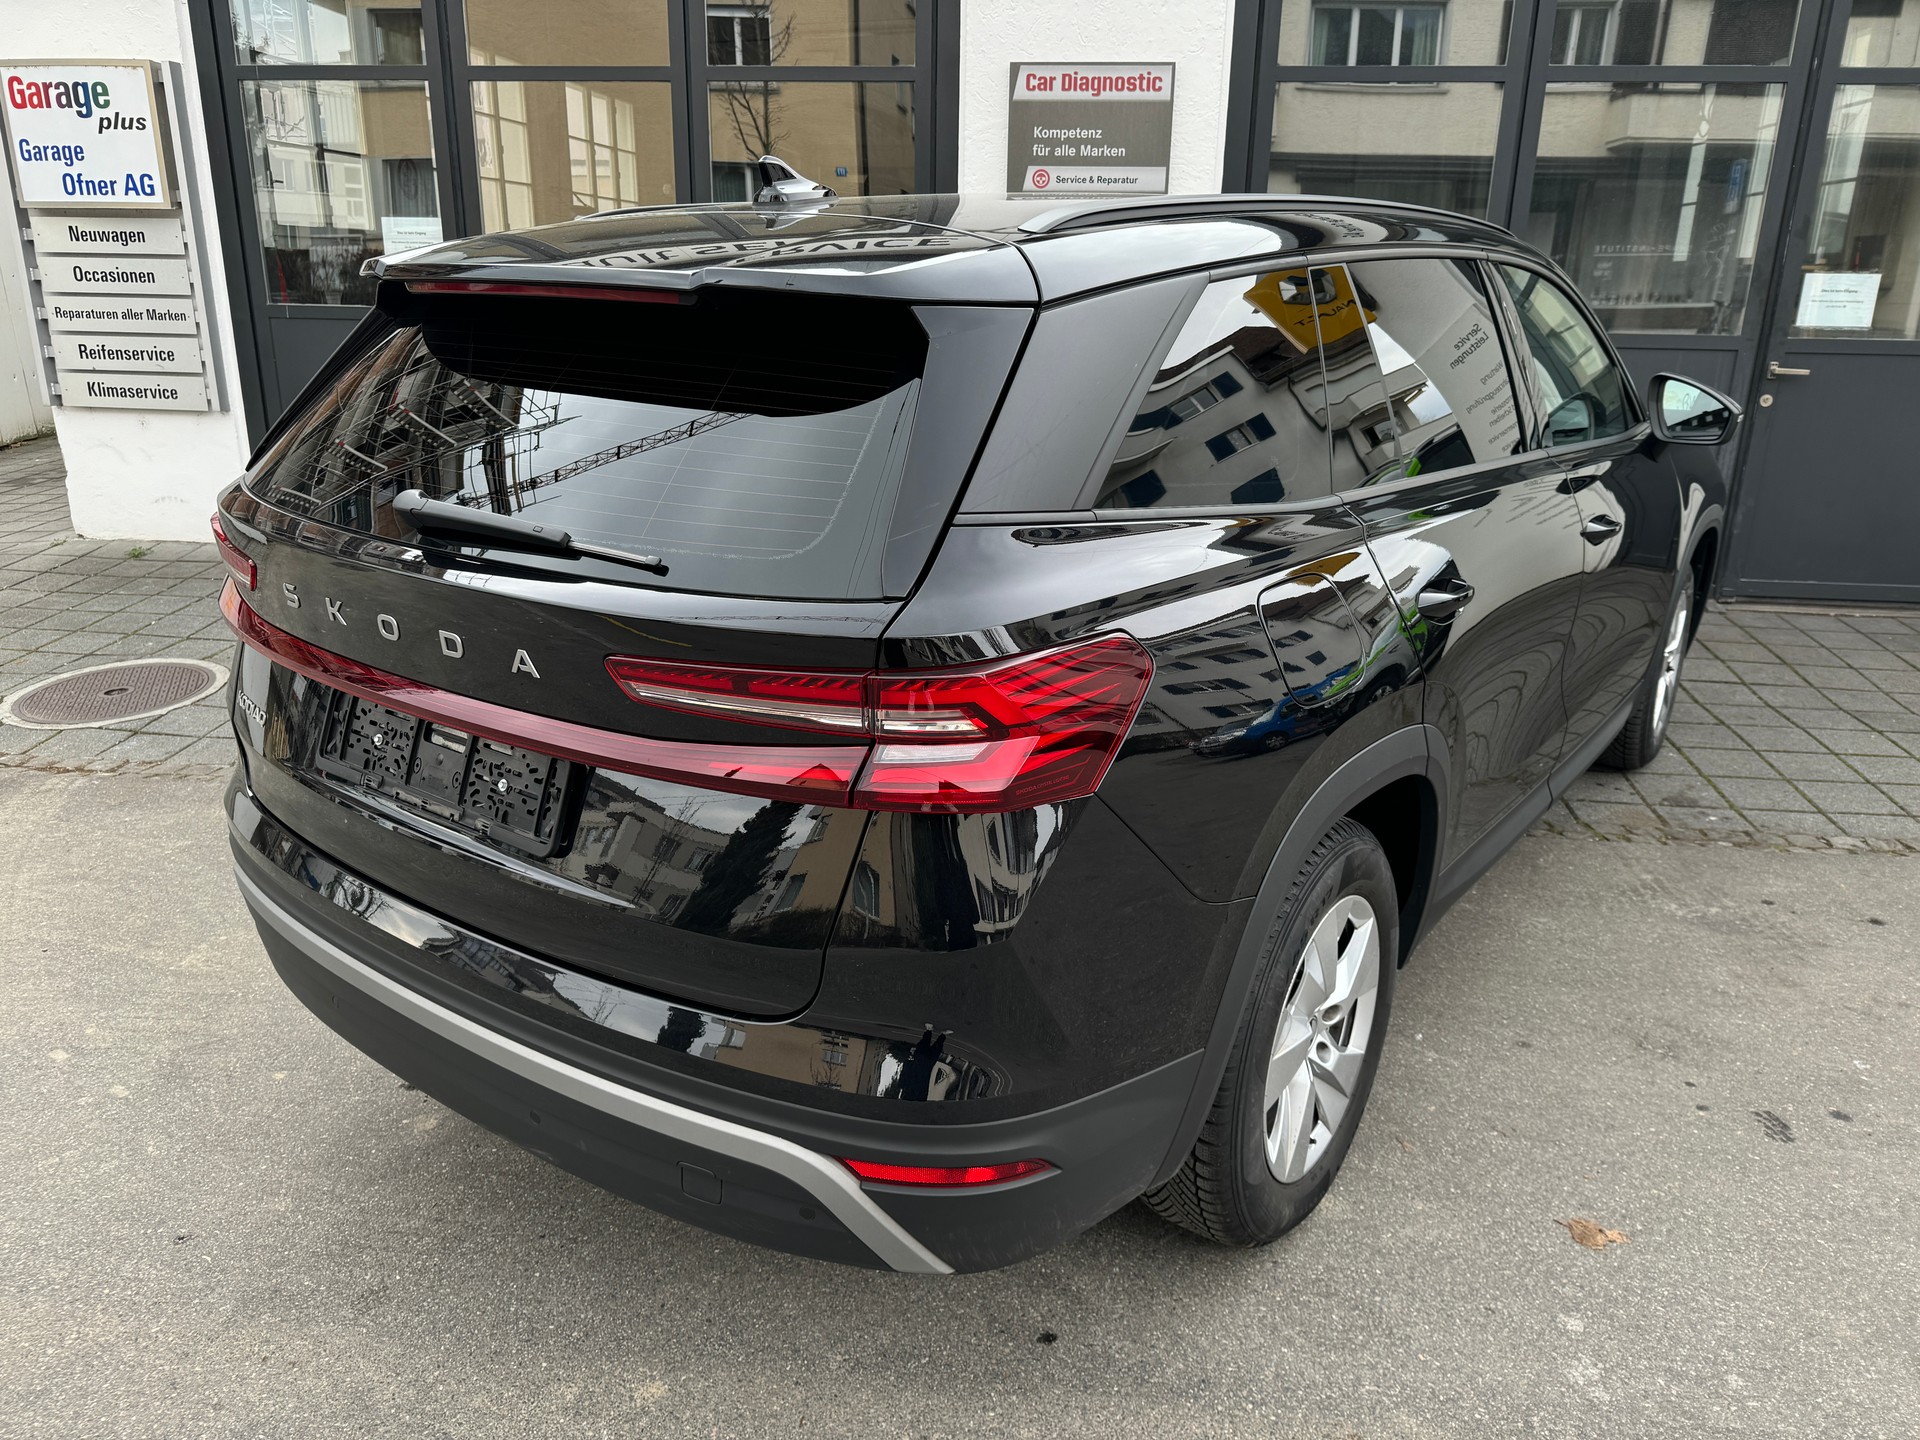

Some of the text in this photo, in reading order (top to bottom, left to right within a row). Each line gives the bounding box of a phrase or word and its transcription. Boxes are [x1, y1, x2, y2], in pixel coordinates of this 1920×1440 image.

[1025, 71, 1163, 97] Car Diagnostic
[7, 75, 111, 118] Garage
[98, 111, 147, 134] plus
[1033, 126, 1103, 141] Kompetenz
[18, 138, 85, 166] Garage
[1032, 144, 1126, 157] für alle Marken
[62, 172, 156, 196] Ofner AG
[1055, 175, 1138, 186] Service & Reparatur
[67, 225, 146, 247] Neuwagen
[73, 265, 156, 284] Occasionen
[54, 306, 187, 322] Reparaturen aller Marken
[78, 343, 176, 362] Reifenservice
[87, 381, 179, 400] Klimaservice
[282, 582, 541, 679] SKODA
[238, 690, 267, 728] KODIAQ
